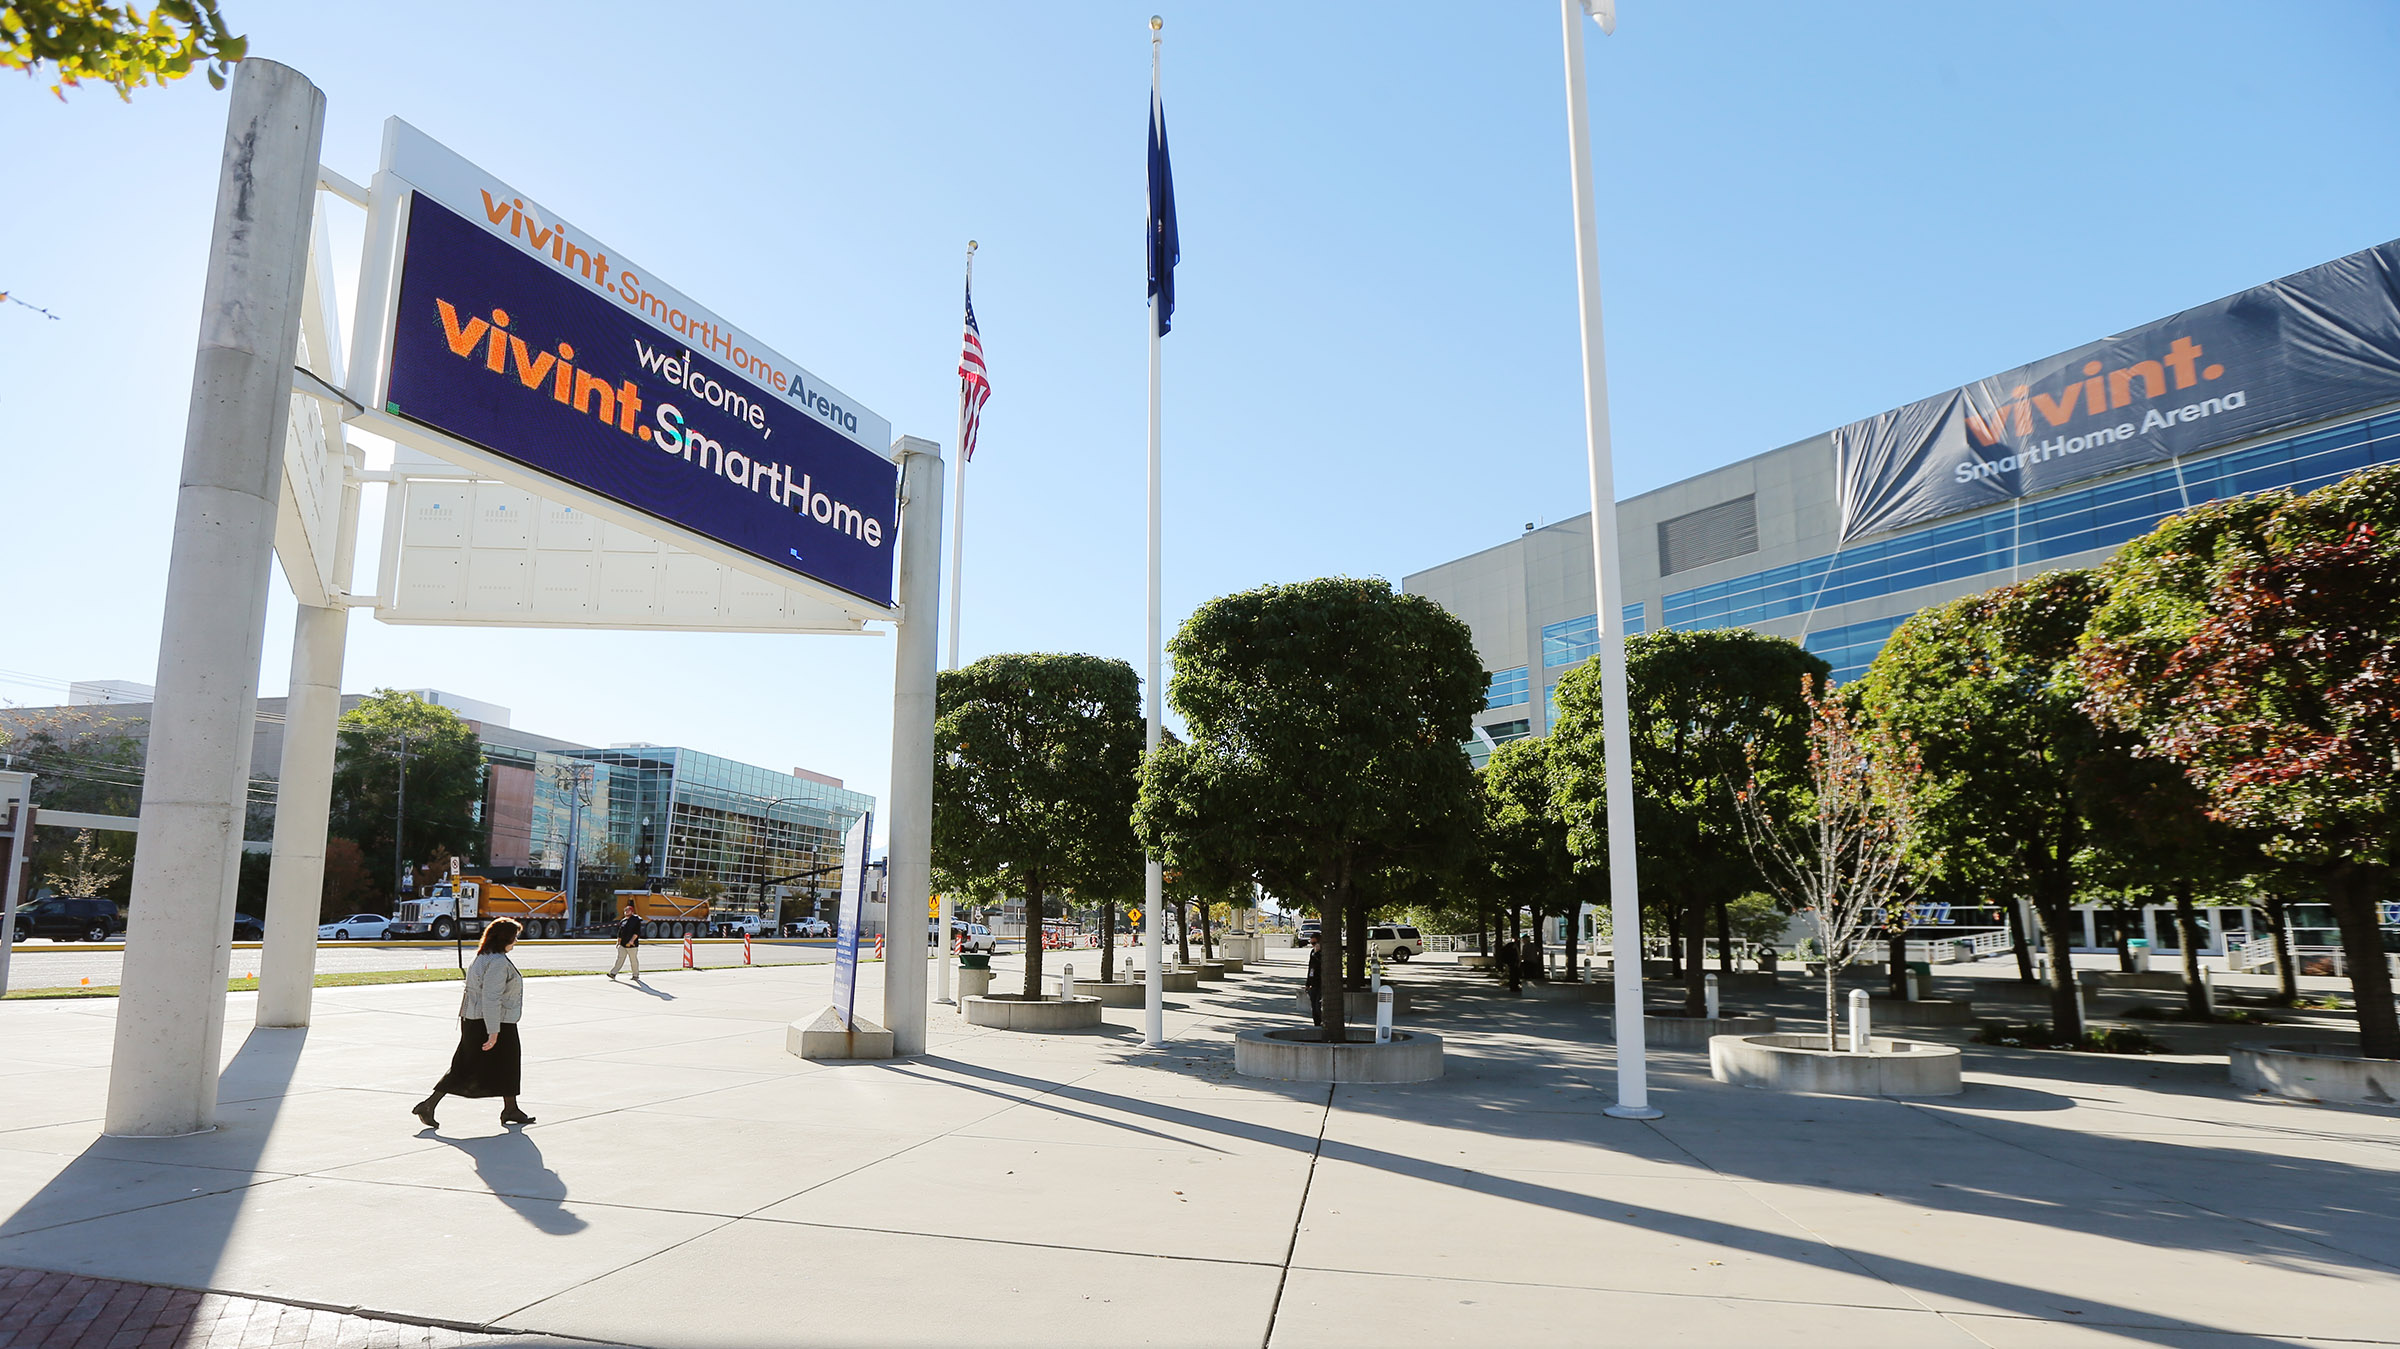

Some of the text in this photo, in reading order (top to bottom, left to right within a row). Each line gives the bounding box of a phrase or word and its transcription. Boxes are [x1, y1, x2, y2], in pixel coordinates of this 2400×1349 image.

[634, 339, 773, 440] welcome,
[1965, 336, 2224, 446] vivint.
[2140, 390, 2247, 434] Arena
